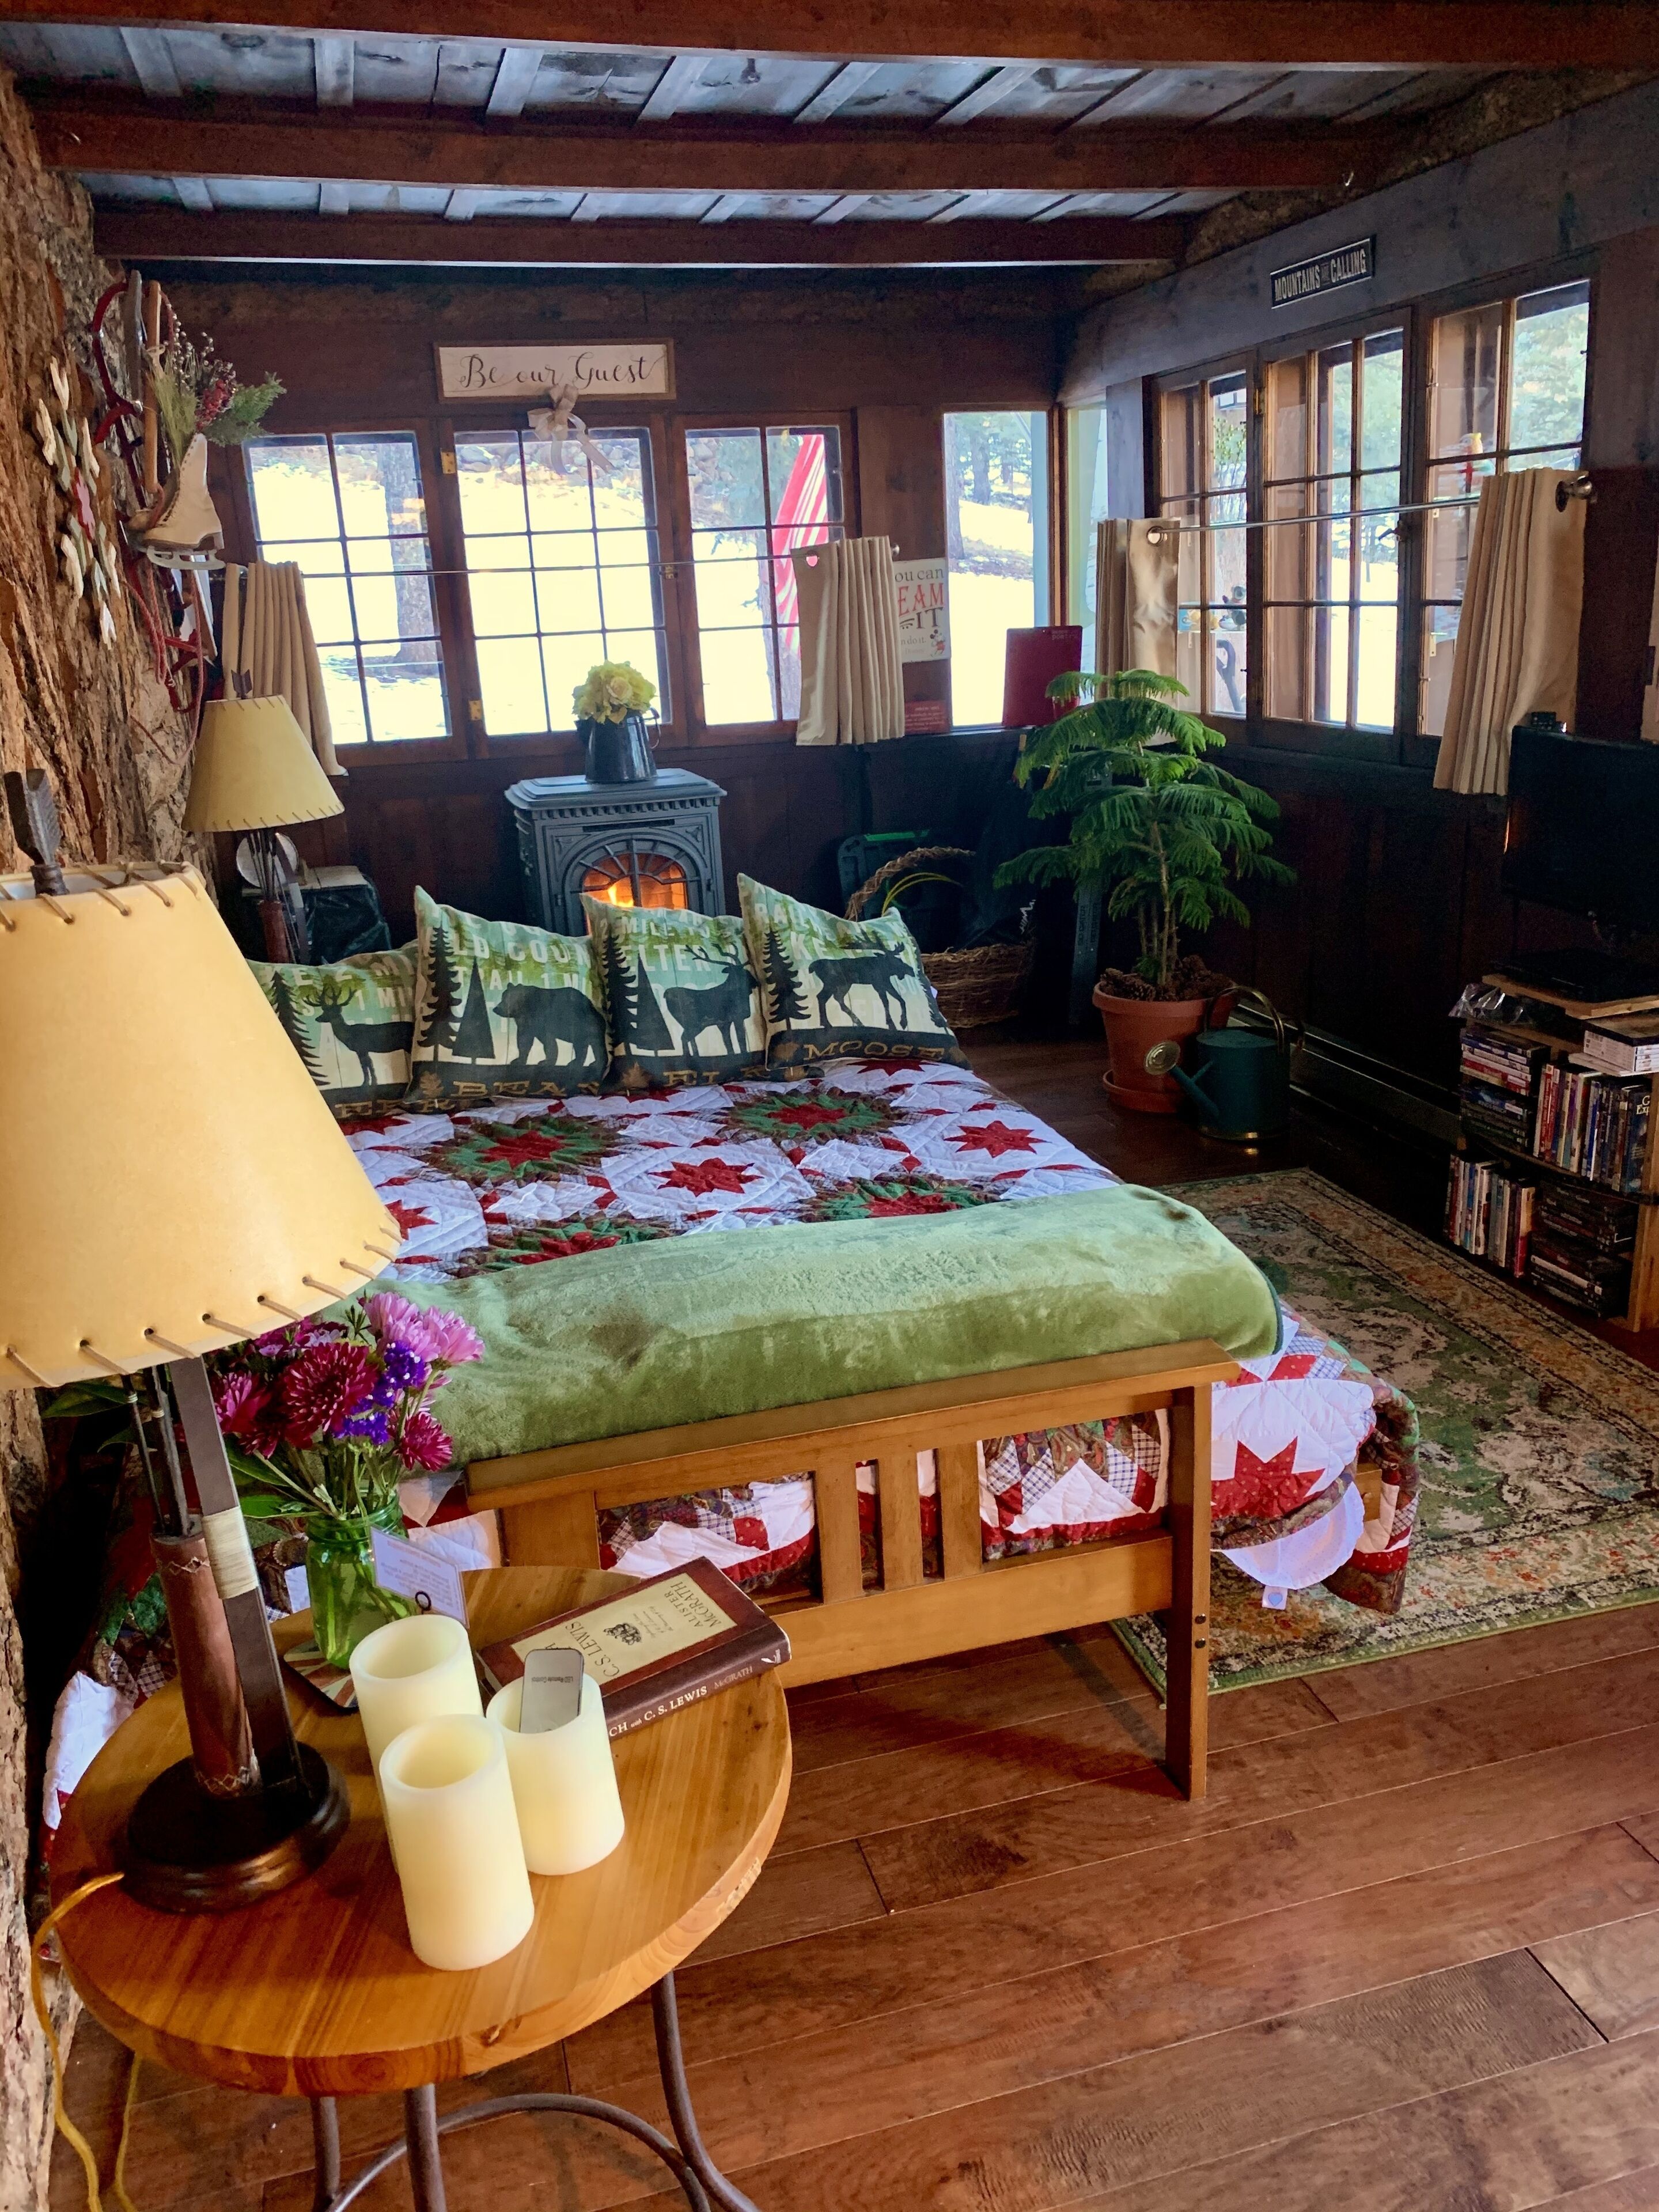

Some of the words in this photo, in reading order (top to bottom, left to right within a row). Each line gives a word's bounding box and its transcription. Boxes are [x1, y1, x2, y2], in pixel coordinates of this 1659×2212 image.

[1275, 264, 1321, 301] MOUNTAINS
[1330, 248, 1367, 283] CALLING
[459, 353, 499, 388] Be
[514, 364, 558, 385] our
[569, 351, 658, 390] Guest
[895, 570, 914, 583] ou
[917, 568, 944, 581] can
[897, 582, 944, 618] EAM
[916, 606, 944, 629] IT
[907, 635, 918, 645] do
[803, 1040, 945, 1061] MOOSE
[664, 1590, 703, 1627] ALISTER
[670, 1581, 722, 1628] McGRATH
[565, 1621, 604, 1656] LEWIS
[594, 1654, 611, 1666] S.
[603, 1664, 620, 1677] C.
[609, 1721, 628, 1737] CH
[643, 1710, 656, 1721] C.
[657, 1705, 668, 1716] S.
[669, 1685, 708, 1710] LEWIS
